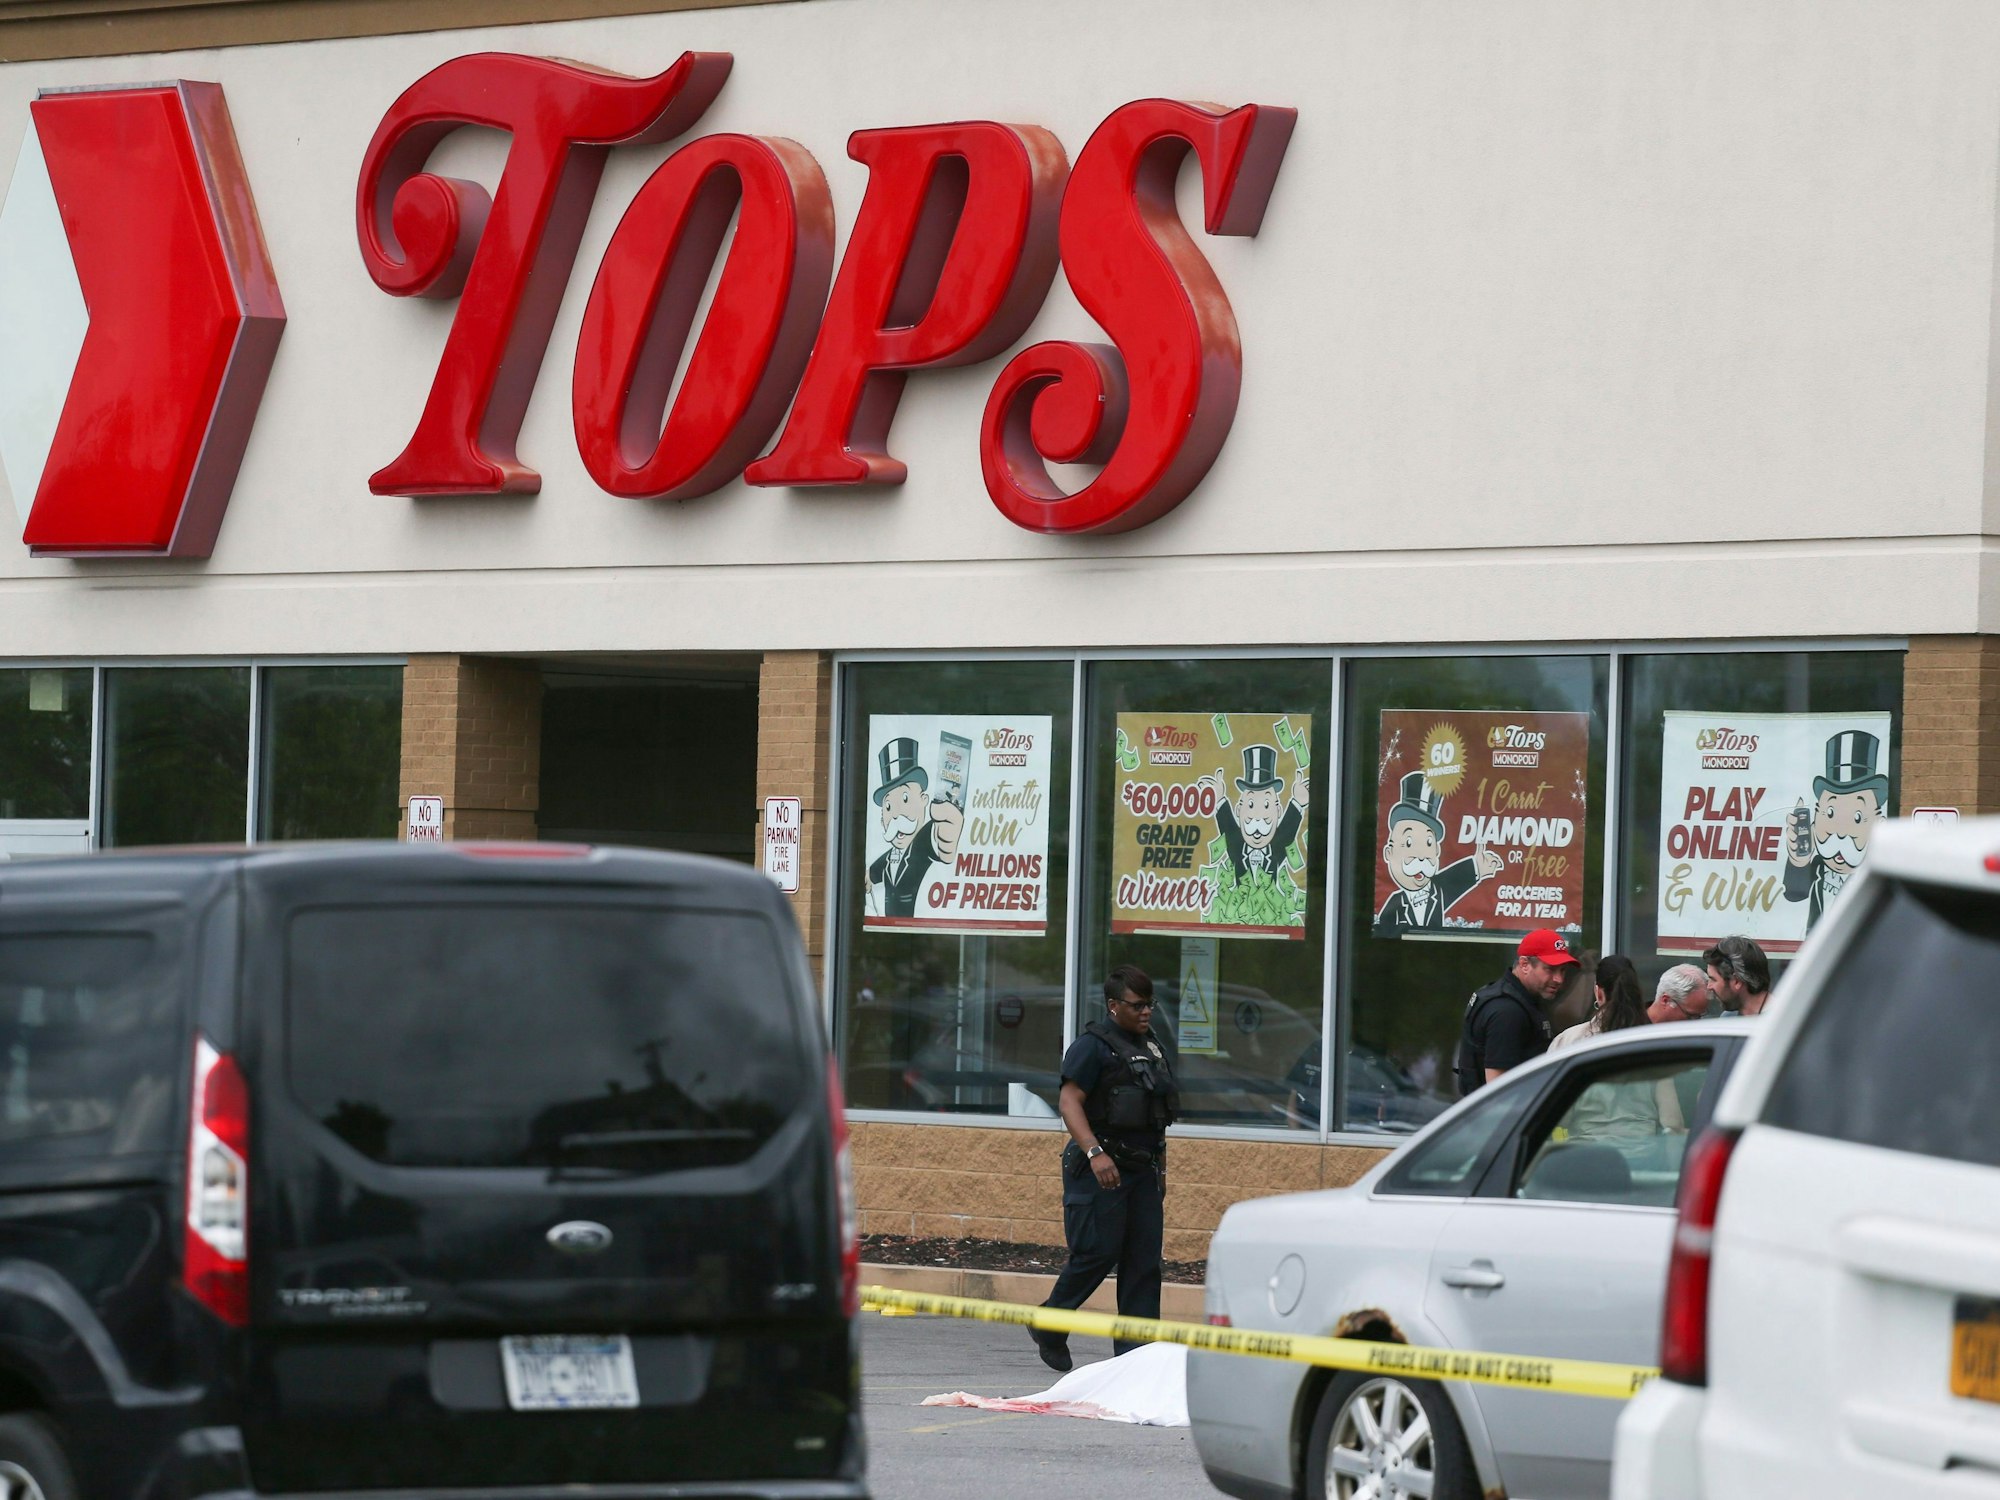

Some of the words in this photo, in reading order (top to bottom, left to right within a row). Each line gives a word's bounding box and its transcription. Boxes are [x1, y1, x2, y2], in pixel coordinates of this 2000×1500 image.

[989, 754, 1026, 766] MONOPOLY
[1151, 753, 1191, 764] MONOPOLY
[1431, 742, 1455, 766] 60
[1494, 754, 1537, 765] MONOPOLY
[1702, 757, 1749, 768] MONOPOLY
[1427, 764, 1461, 777] WINNERS!
[972, 779, 1042, 826] instantly
[1122, 781, 1216, 821] $60,000
[1477, 777, 1488, 809] 1
[1491, 779, 1554, 815] Carat
[1684, 786, 1766, 821] PLAY
[419, 806, 431, 821] NO
[776, 807, 789, 823] NO
[411, 826, 440, 842] PARKING
[767, 828, 797, 844] PARKING
[1136, 824, 1200, 846] GRAND
[1458, 815, 1574, 847] DIAMOND
[1667, 824, 1782, 861] ONLINE
[774, 847, 788, 858] FIRE
[1141, 847, 1195, 869] PRIZE
[773, 861, 789, 872] LANE
[955, 853, 1042, 879] MILLIONS
[1508, 850, 1523, 863] OR
[1522, 844, 1570, 886] free
[928, 882, 959, 908] OF
[959, 883, 1040, 910] PRIZES!
[1497, 885, 1563, 901] GROCERIES
[1495, 902, 1521, 916] FOR
[1521, 903, 1532, 917] A
[1534, 904, 1567, 918] YEAR
[1369, 1348, 1415, 1371] POLICE
[1419, 1351, 1447, 1373] LINE
[1452, 1355, 1470, 1375] DO
[1476, 1357, 1501, 1379] NOT
[1505, 1360, 1553, 1384] CROSS
